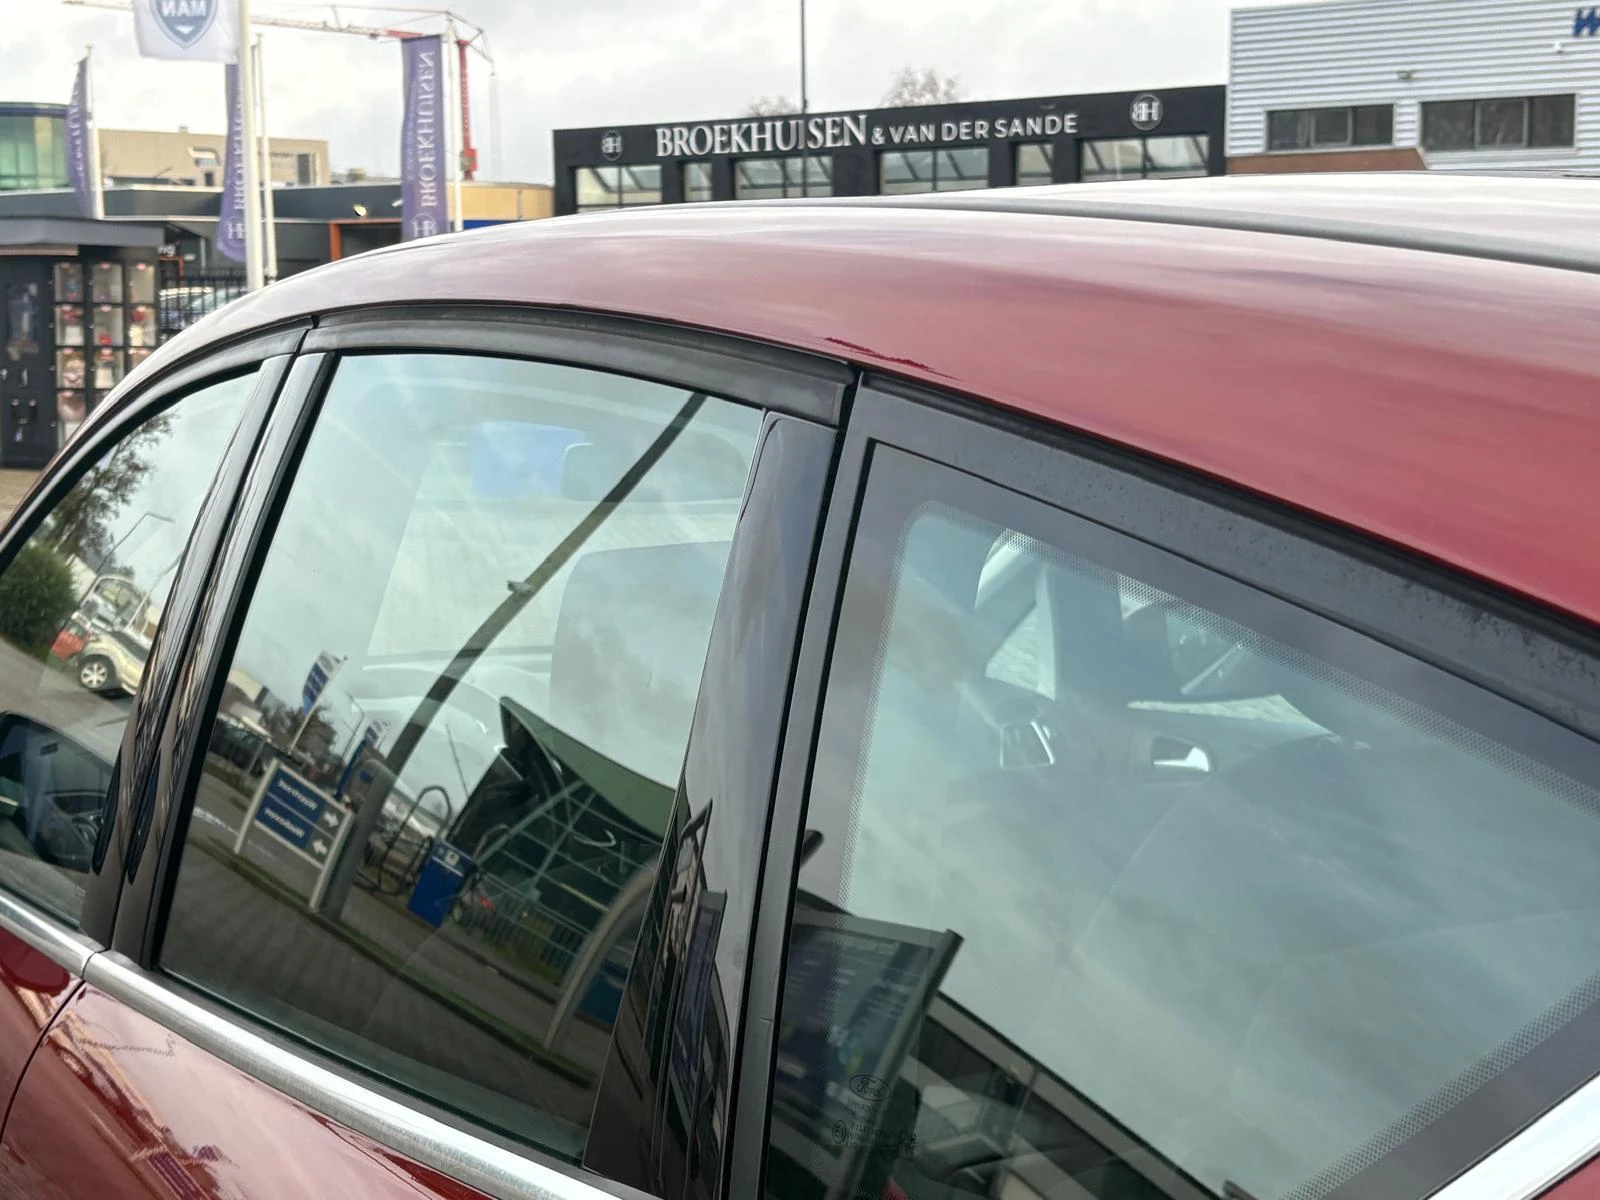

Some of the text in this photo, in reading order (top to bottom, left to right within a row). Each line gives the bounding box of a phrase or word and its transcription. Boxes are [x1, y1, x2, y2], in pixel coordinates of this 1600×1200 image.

[655, 112, 1080, 157] BROEKHUISEN & VAN DER SANDE
